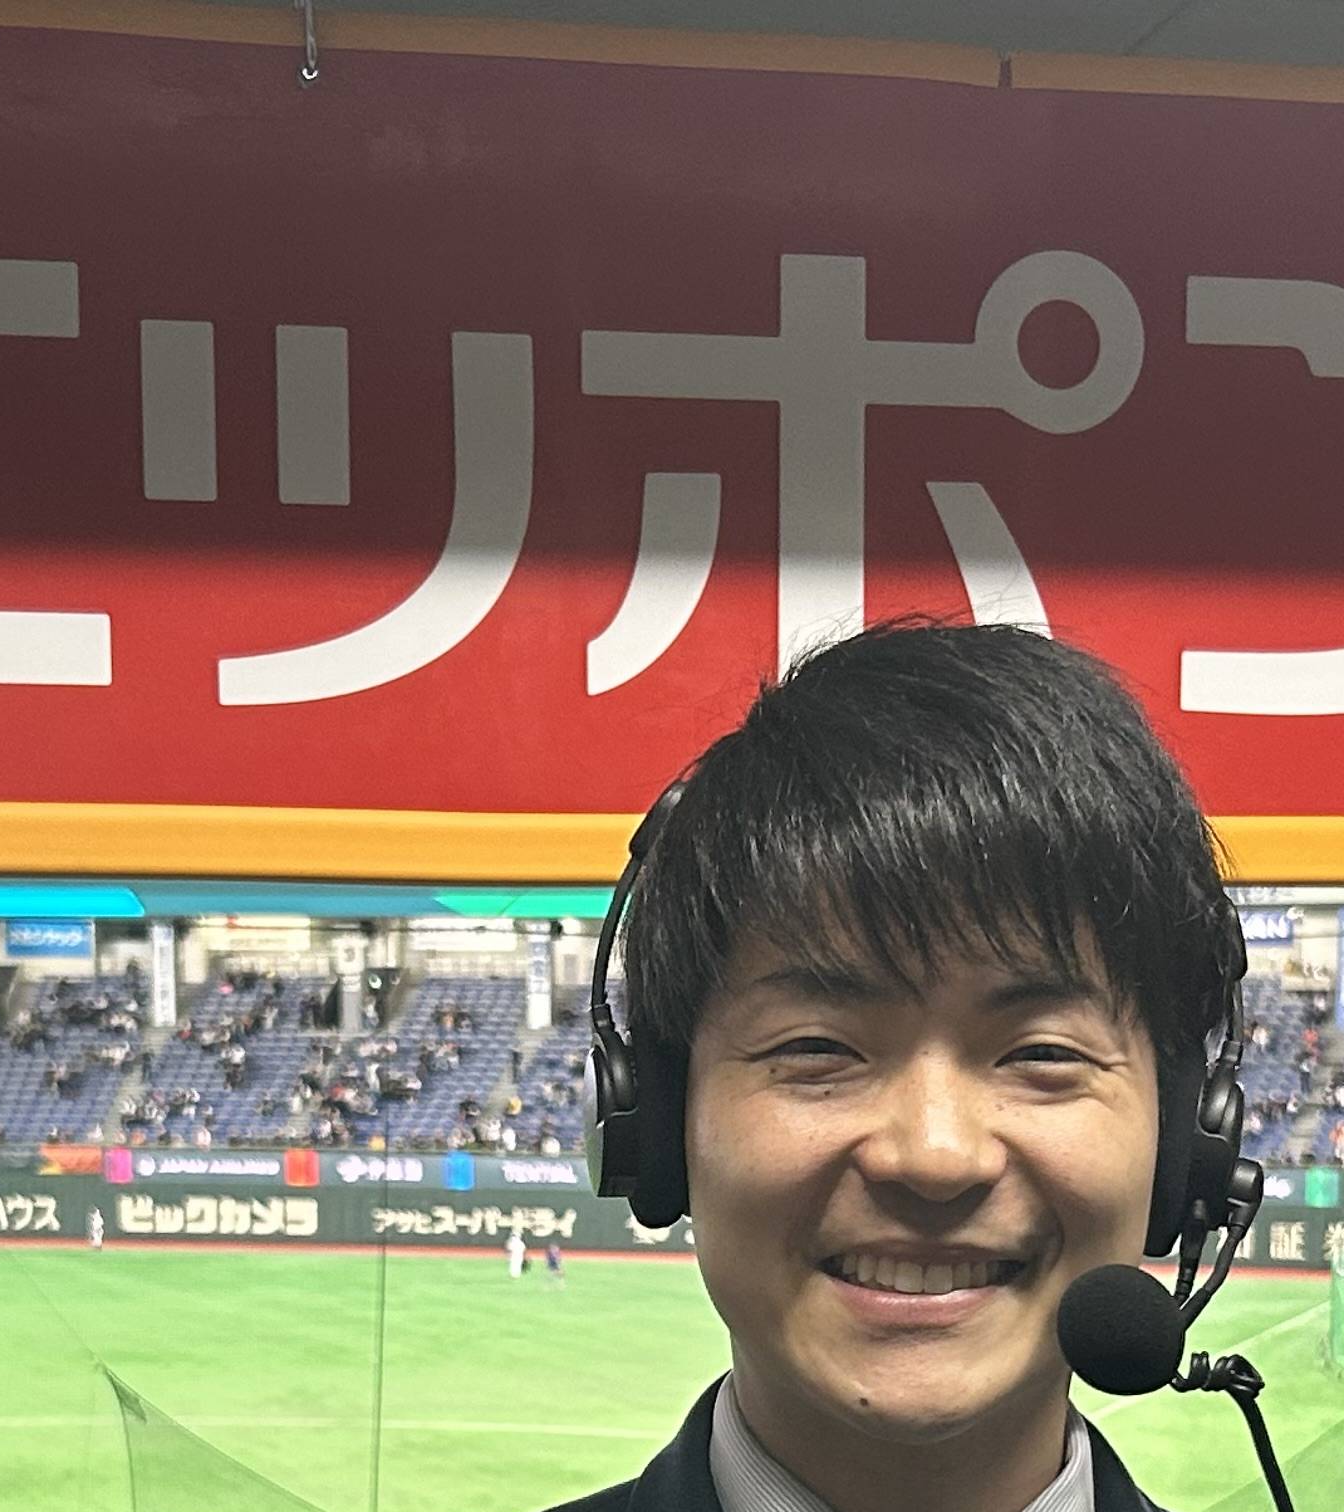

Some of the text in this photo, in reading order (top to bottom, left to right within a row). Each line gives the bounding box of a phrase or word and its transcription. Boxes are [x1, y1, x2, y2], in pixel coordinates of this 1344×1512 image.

[118, 1194, 319, 1236] ビックカメラ
